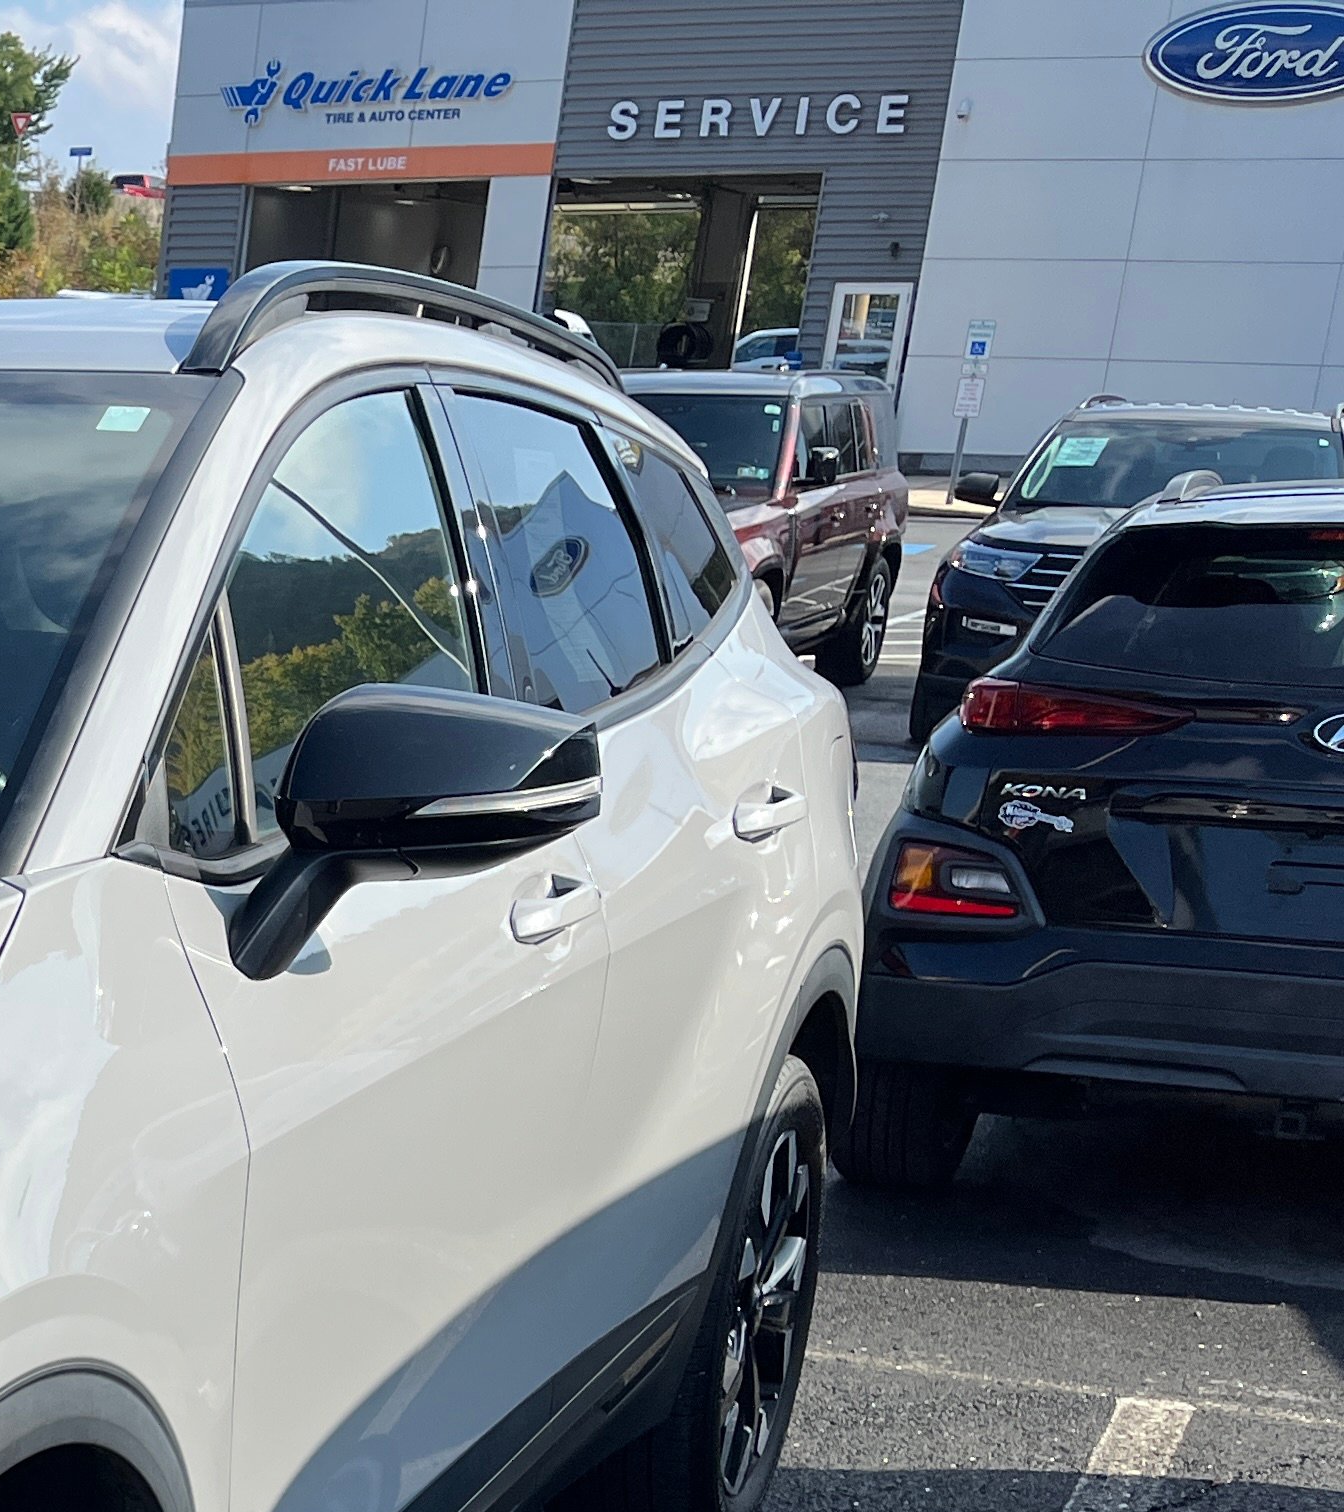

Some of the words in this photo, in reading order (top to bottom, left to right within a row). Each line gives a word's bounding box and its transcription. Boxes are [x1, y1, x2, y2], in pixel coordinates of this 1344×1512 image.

[1196, 23, 1344, 80] Ford
[282, 68, 402, 110] Quick
[403, 66, 511, 100] Lane
[325, 112, 354, 124] TIRE
[357, 111, 366, 123] &
[368, 109, 405, 123] AUTO
[407, 107, 461, 122] CENTER
[607, 93, 910, 141] SERVICE
[328, 157, 365, 172] FAST
[367, 156, 408, 171] LUBE
[1000, 782, 1087, 800] KONA
